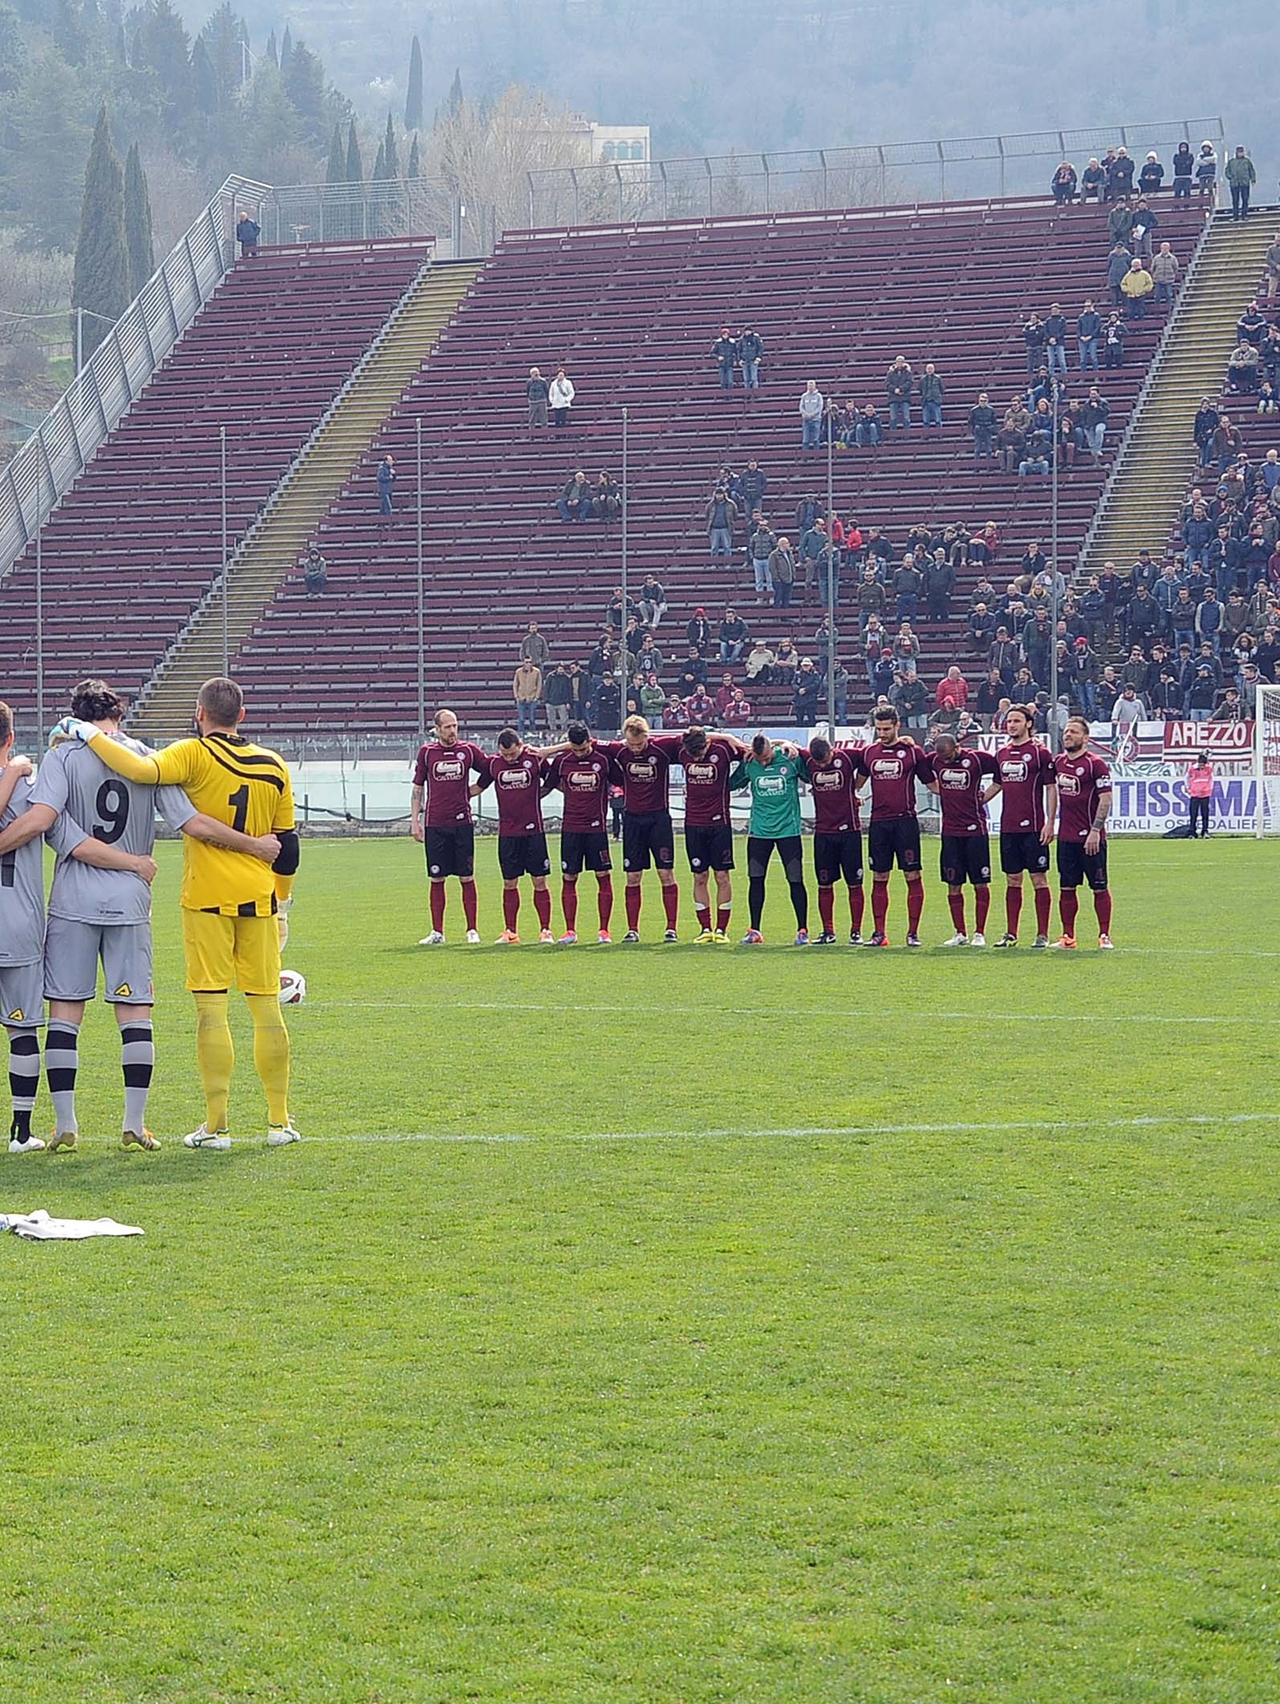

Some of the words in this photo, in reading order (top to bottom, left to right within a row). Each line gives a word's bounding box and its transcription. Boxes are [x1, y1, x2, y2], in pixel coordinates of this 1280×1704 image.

[1171, 721, 1247, 747] AREZZO
[92, 779, 130, 844] 9
[228, 784, 249, 833] 1
